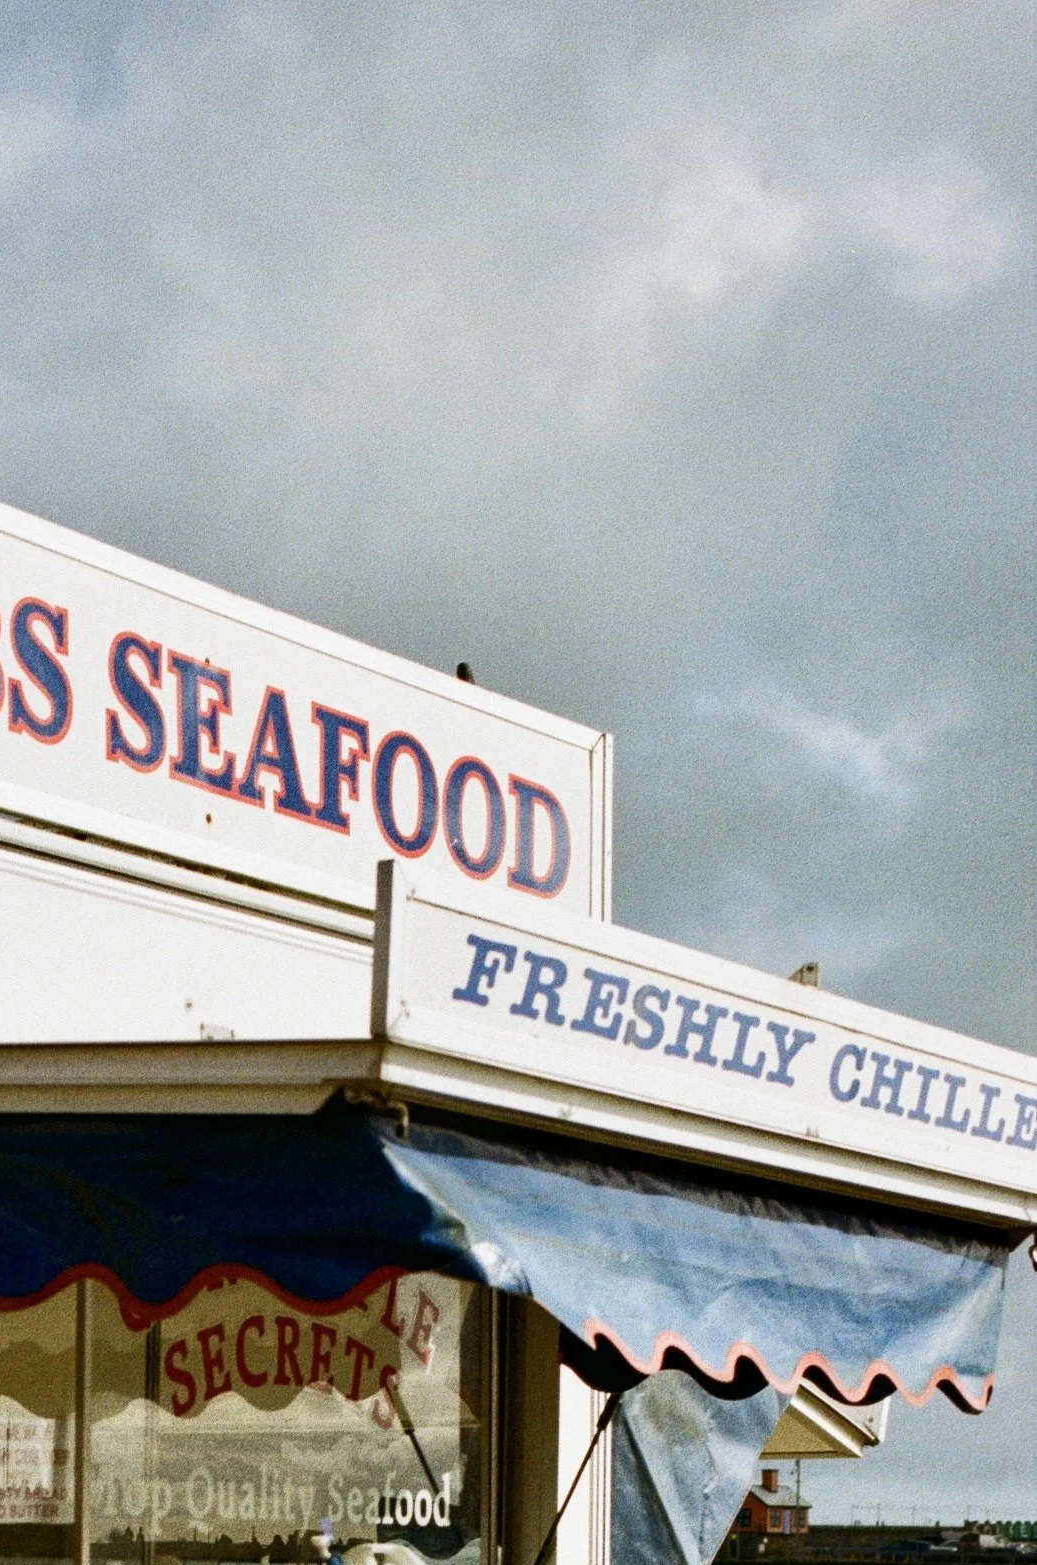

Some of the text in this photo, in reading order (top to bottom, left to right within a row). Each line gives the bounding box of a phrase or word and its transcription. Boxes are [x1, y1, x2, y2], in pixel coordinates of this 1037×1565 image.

[105, 631, 571, 899] SEAFOOD
[452, 934, 815, 1087] FRESHLY
[164, 1314, 398, 1431] SECRETS
[185, 1464, 316, 1533] Quality
[327, 1471, 452, 1527] Seafood
